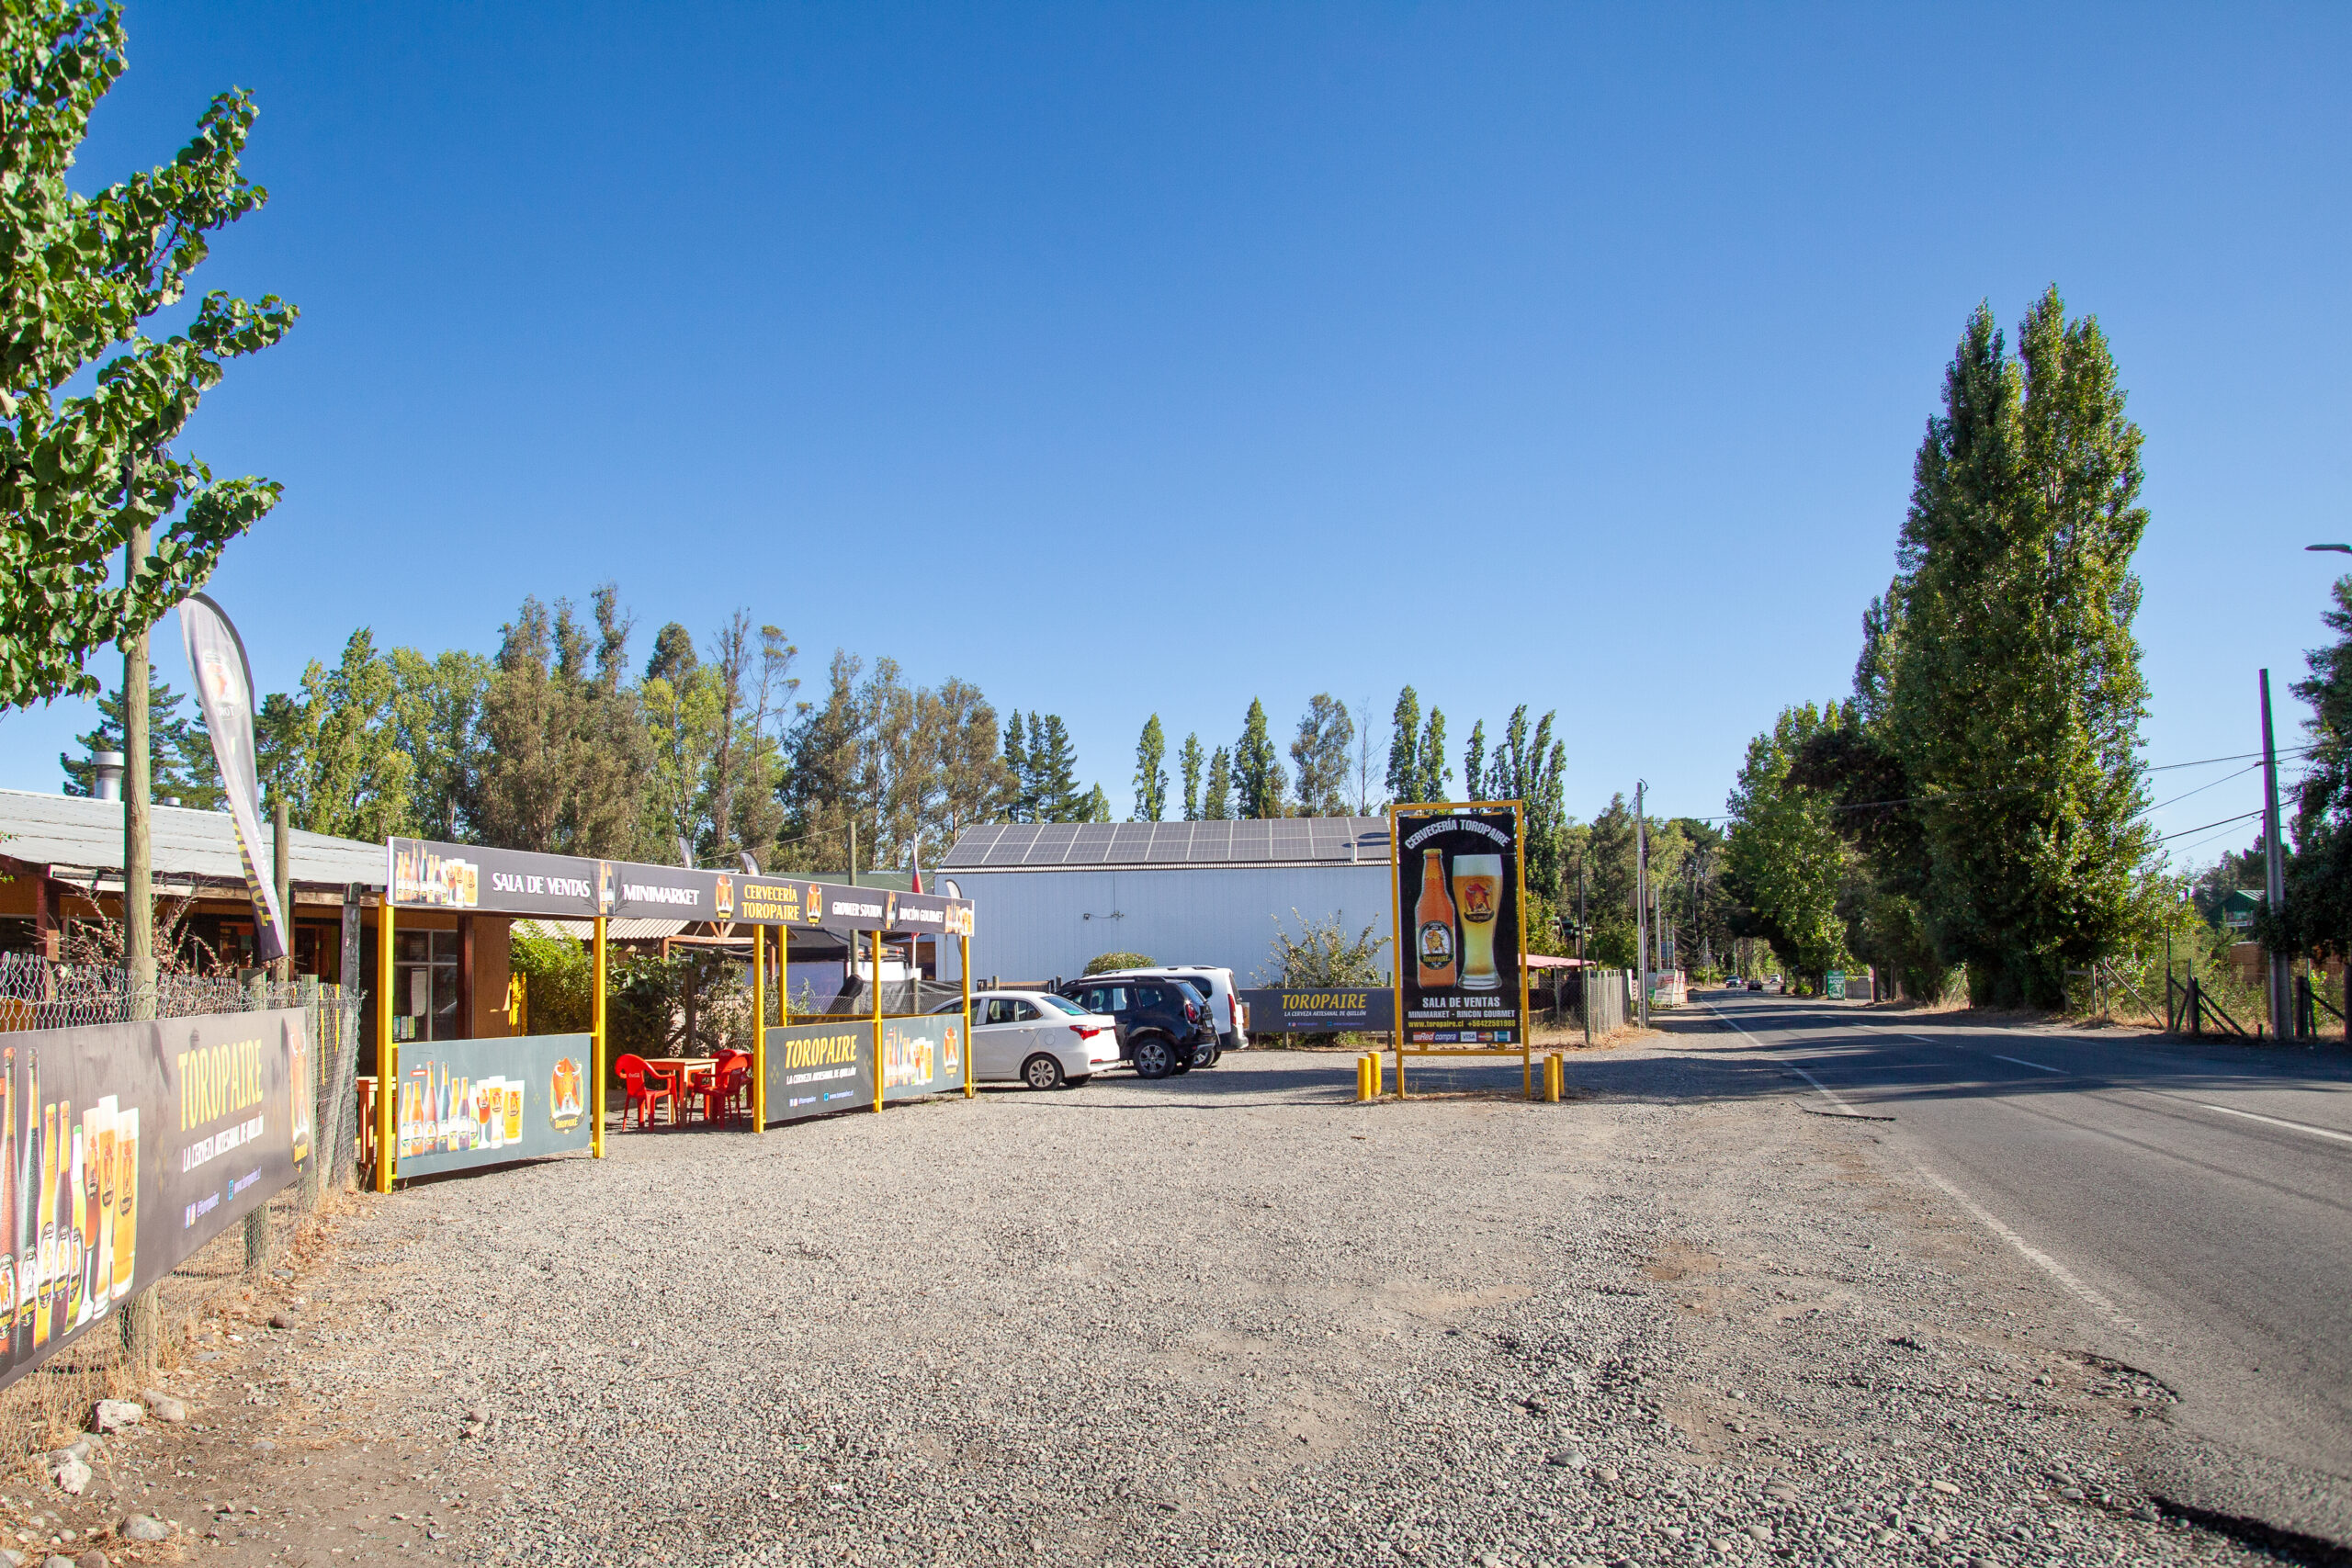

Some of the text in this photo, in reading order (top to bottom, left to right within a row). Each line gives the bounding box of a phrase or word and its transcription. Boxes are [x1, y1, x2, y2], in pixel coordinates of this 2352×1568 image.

[1404, 818, 1511, 850] CERVECERÍA TOROPAIRE
[492, 873, 591, 898] SALA DE VENTAS
[623, 884, 700, 906] MINIMARKET
[743, 884, 798, 903] CERVECERÍA
[741, 901, 800, 921] TOROPAIRE
[860, 904, 882, 919] STATION
[920, 908, 944, 923] GOURMET
[1283, 993, 1368, 1010] TOROPAIRE
[1422, 997, 1500, 1009] SALA DE VENTAS
[1408, 1010, 1450, 1019] MINIMARKET
[1483, 1010, 1515, 1018] GOURMET
[1419, 1032, 1434, 1041] Red
[785, 1034, 858, 1069] TOROPAIRE
[177, 1038, 264, 1133] TOROPAIRE
[786, 1075, 793, 1085] LA
[182, 1145, 191, 1174] LA
